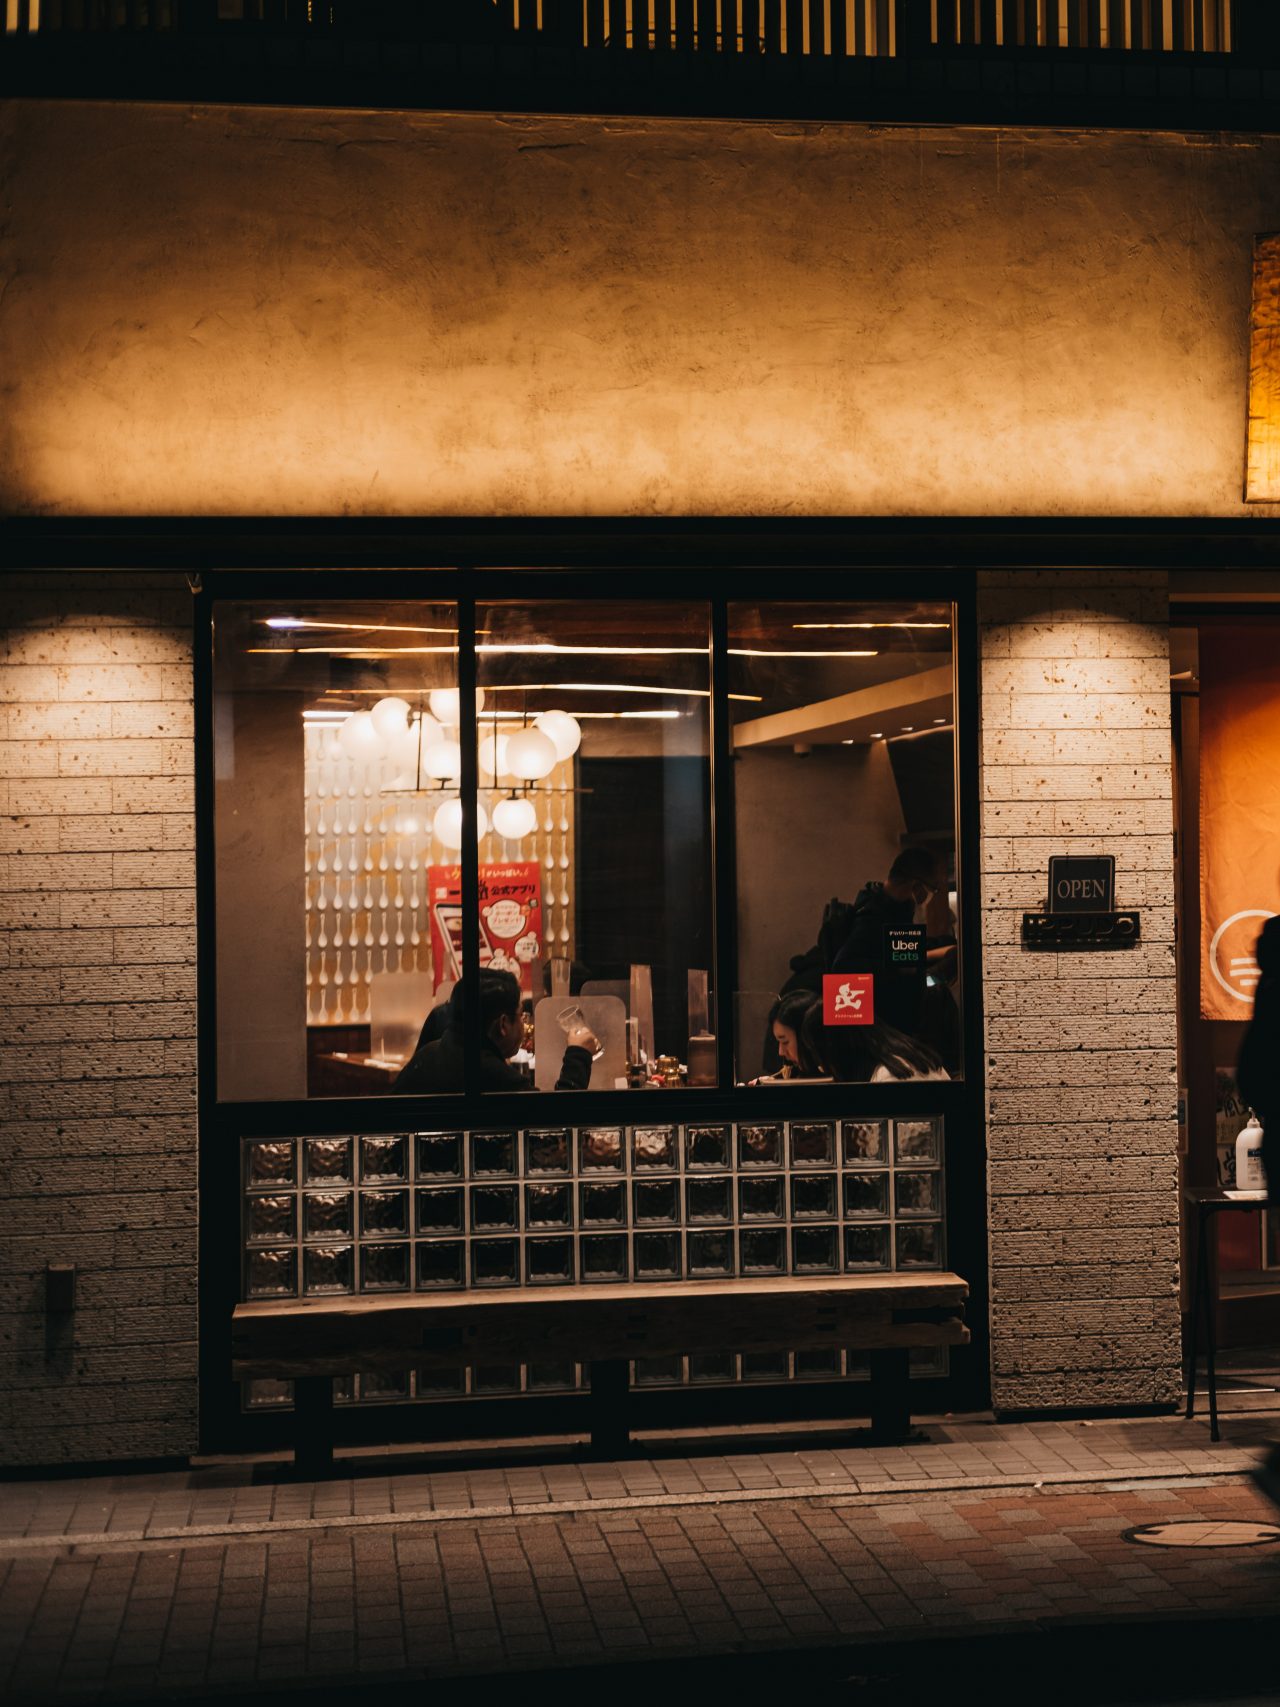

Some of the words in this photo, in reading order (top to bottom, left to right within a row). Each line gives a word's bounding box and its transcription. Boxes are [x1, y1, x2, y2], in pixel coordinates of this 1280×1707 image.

[1057, 879, 1106, 898] OPEN
[892, 940, 919, 950] Uber
[892, 951, 919, 961] Eats
